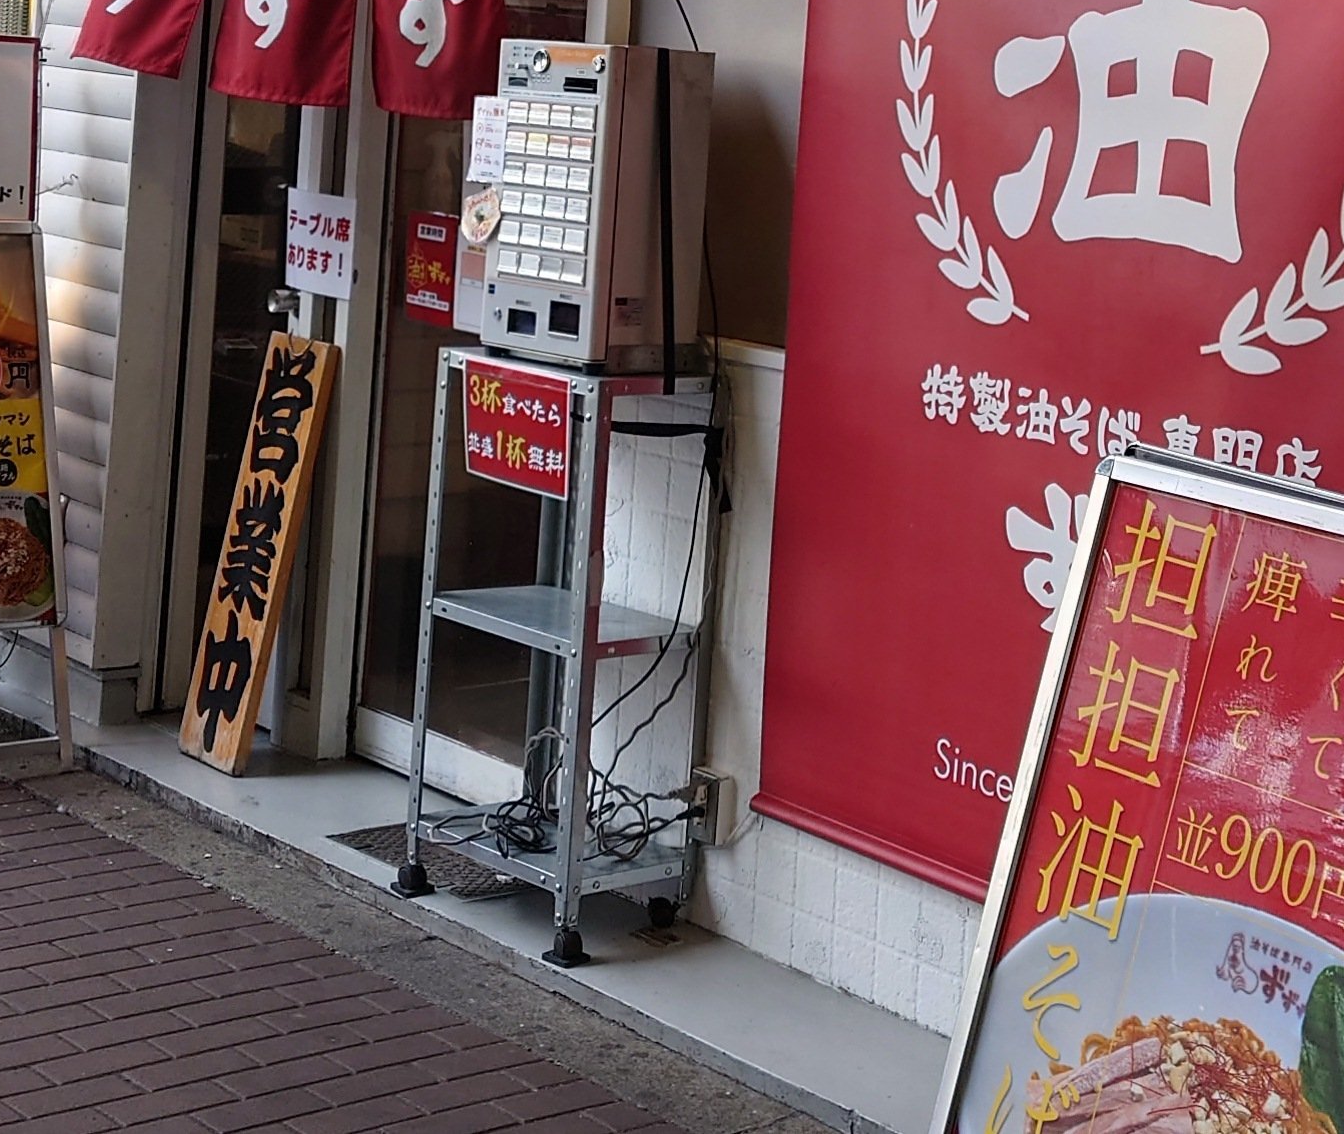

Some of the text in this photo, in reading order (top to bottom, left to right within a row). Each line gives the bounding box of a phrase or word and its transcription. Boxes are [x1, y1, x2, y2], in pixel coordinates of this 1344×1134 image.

[289, 209, 351, 242] テーブル席
[288, 242, 343, 277] あります！
[470, 374, 561, 427] 3杯食べたら
[468, 430, 564, 478] 並盛1杯無料
[196, 346, 316, 754] 営業中
[1227, 551, 1308, 750] 痺れて
[934, 738, 1014, 802] Since
[986, 499, 1217, 1134] 担担油そば
